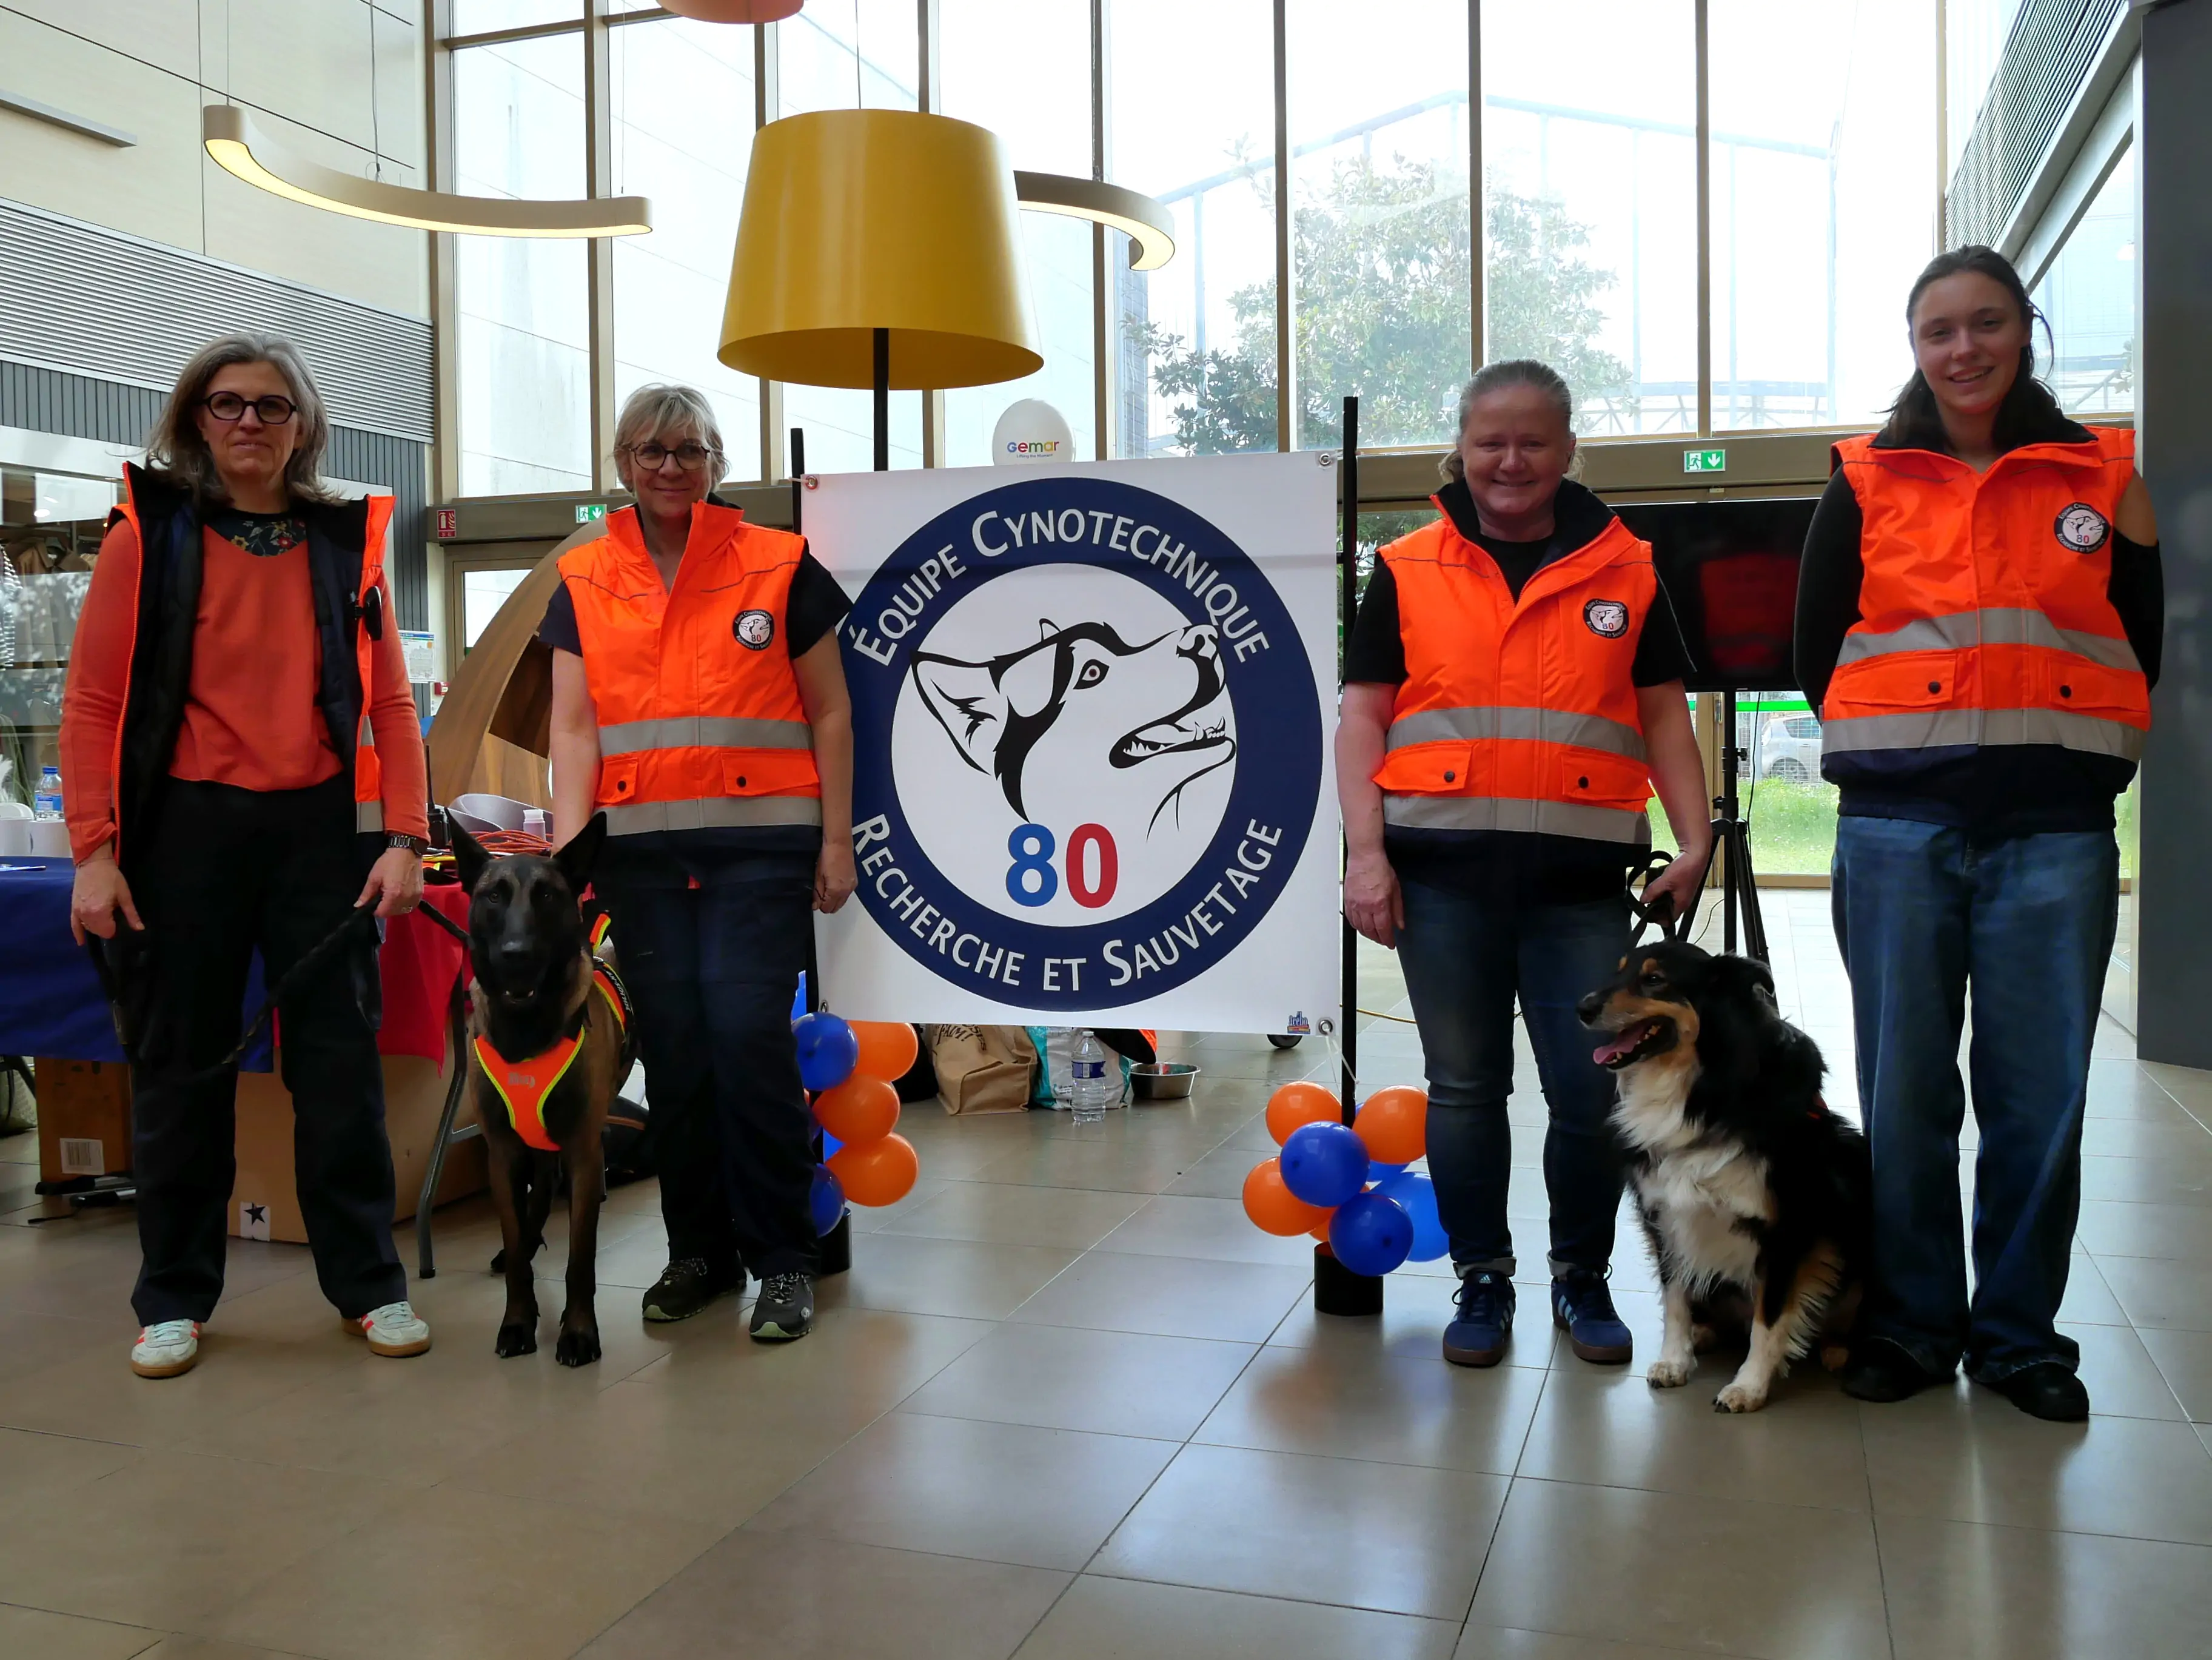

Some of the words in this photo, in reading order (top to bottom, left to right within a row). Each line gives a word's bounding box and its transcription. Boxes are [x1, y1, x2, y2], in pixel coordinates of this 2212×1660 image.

[1007, 441, 1059, 452] Gemar
[2077, 534, 2090, 544] 80
[849, 544, 967, 665] ÉQUIPE
[973, 509, 1269, 662] CYNOTECHNIQUE
[852, 814, 1025, 986] RECHERCHE
[1043, 958, 1086, 991] ET
[1102, 819, 1282, 986] SAUVETAGE
[1007, 823, 1118, 909] 80
